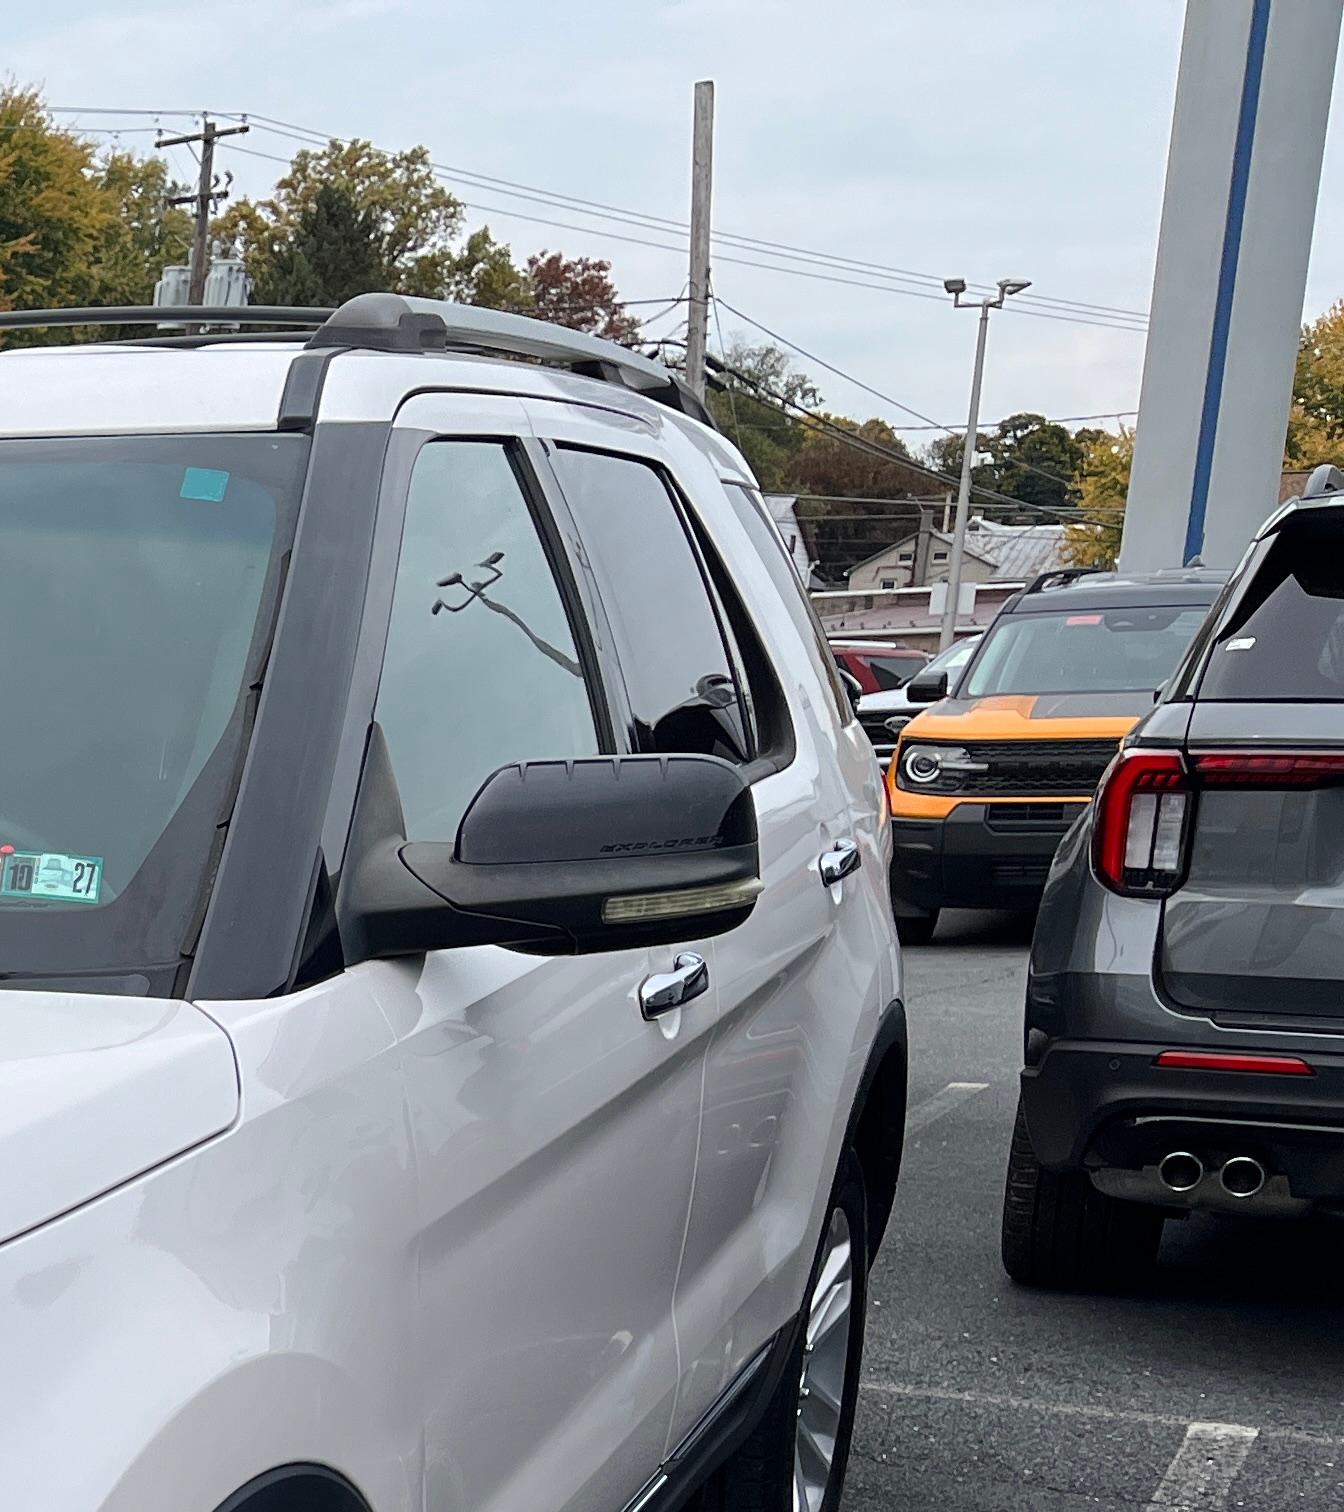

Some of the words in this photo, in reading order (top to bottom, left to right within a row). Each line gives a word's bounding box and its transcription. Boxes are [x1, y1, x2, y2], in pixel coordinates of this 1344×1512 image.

[599, 835, 725, 853] EXPLORER
[9, 864, 32, 891] 10
[72, 862, 96, 894] 27
